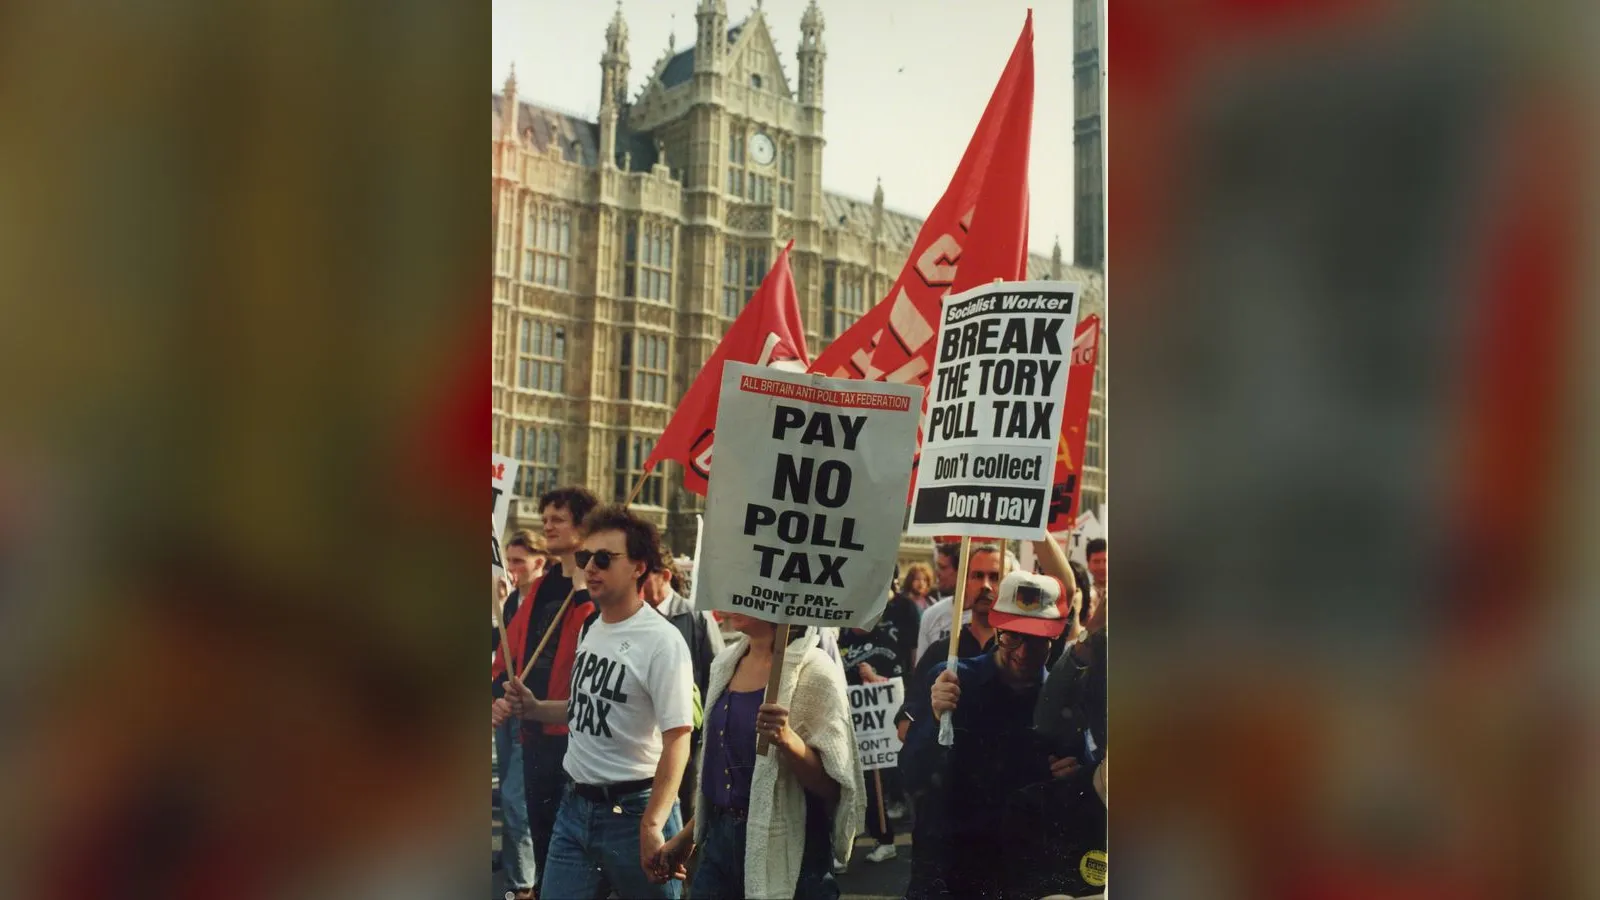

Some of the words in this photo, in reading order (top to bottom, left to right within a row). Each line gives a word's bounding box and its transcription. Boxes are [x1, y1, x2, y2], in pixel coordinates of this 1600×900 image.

[947, 297, 996, 321] Socialist
[1002, 295, 1068, 310] Worker
[940, 318, 1064, 363] BREAK
[743, 380, 759, 390] ALL
[761, 381, 794, 395] BRITAIN
[796, 386, 815, 398] ANTI
[816, 389, 838, 402] POLL
[840, 392, 857, 403] TAX
[857, 394, 908, 408] FEDERATION
[937, 362, 969, 402] THE
[979, 359, 1061, 396] TORY
[772, 406, 867, 450] PAY
[928, 402, 978, 442] POLL
[992, 401, 1055, 439] TAX
[772, 453, 852, 508] NO
[935, 456, 968, 480] Don't
[973, 453, 1042, 480] collect
[947, 492, 991, 521] Don't
[995, 496, 1037, 523] pay
[744, 503, 864, 551] POLL
[753, 544, 848, 587] TAX
[732, 595, 779, 615] DON'T
[785, 602, 853, 620] COLLECT
[752, 586, 798, 604] DON'T
[804, 595, 838, 607] PAY-
[578, 653, 627, 703] POLL
[851, 685, 894, 708] ON'T
[576, 693, 612, 738] TAX
[854, 710, 886, 732] PAY
[859, 738, 890, 751] ON'T
